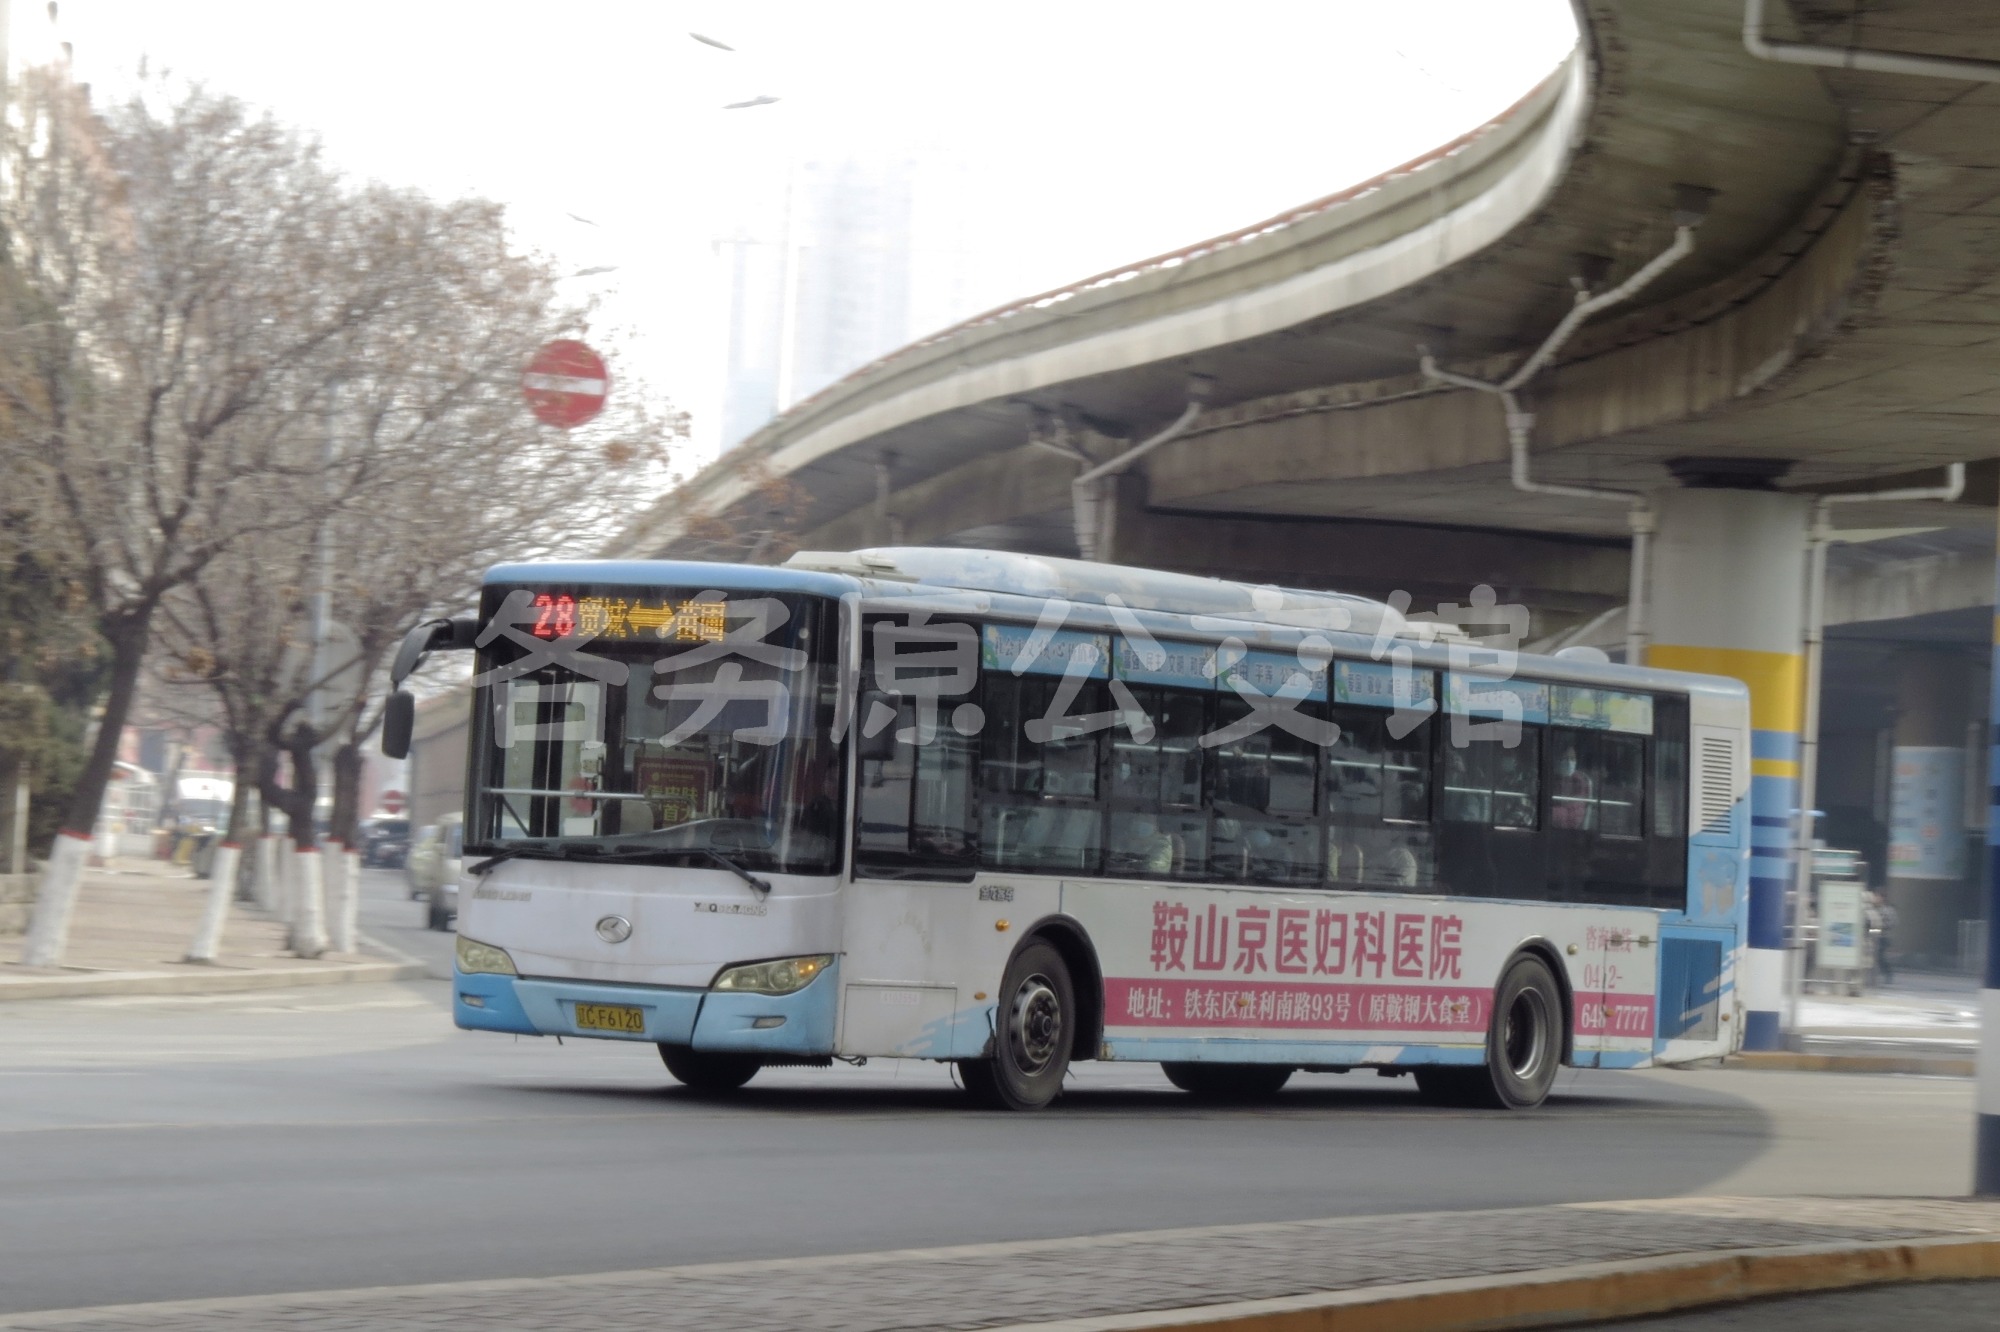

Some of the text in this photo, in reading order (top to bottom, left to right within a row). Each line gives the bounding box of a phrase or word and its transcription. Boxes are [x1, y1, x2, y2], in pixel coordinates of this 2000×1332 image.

[534, 594, 574, 635] 28
[1150, 900, 1464, 981] 鞍山京医妇科医院
[1583, 963, 1623, 989] 042-
